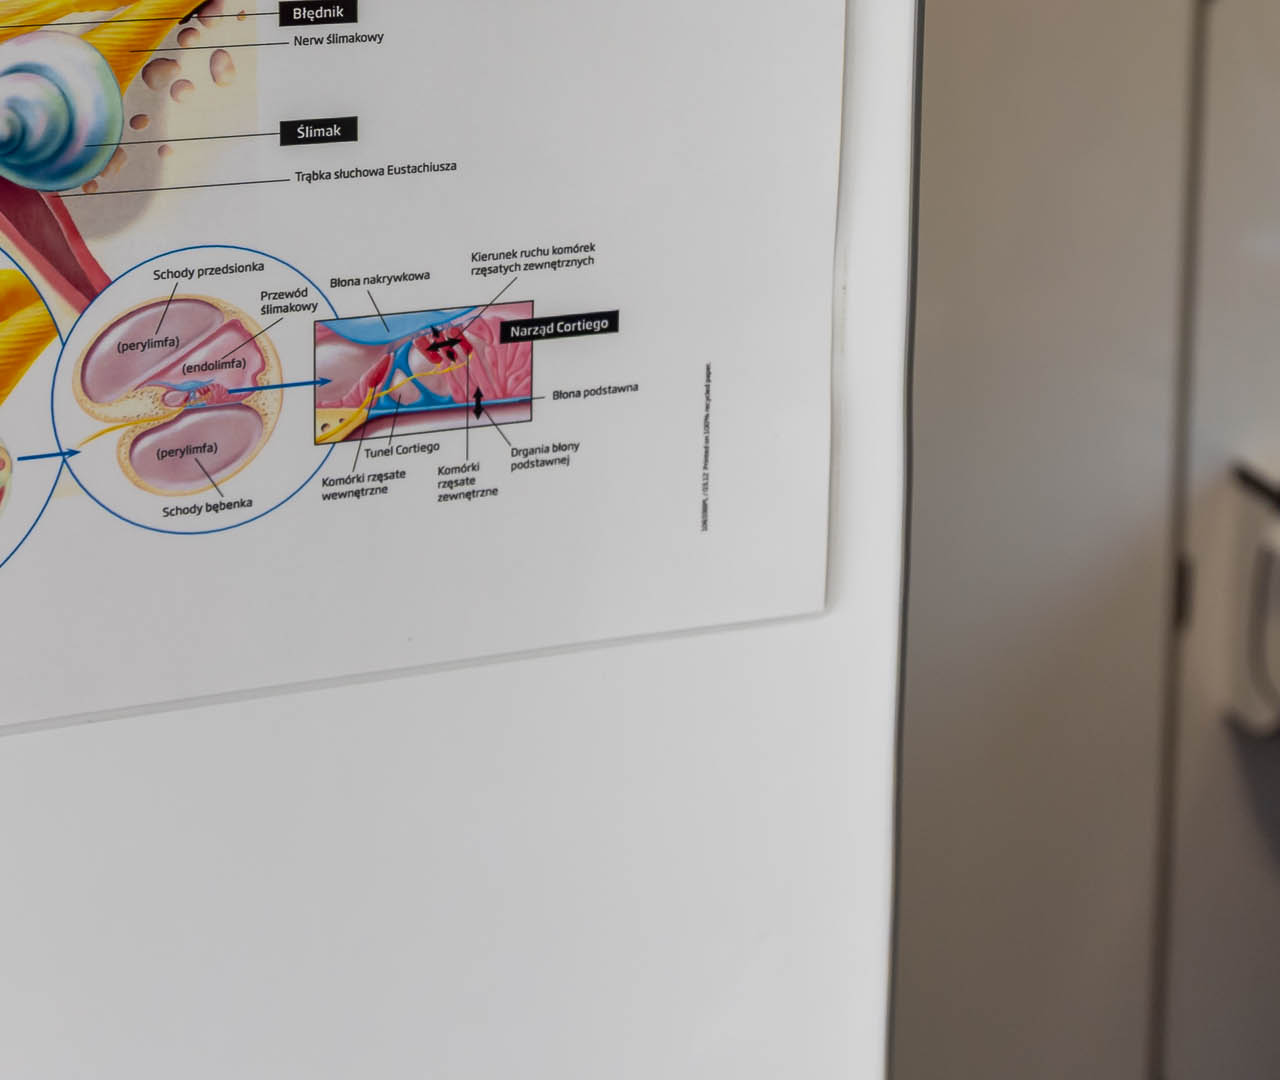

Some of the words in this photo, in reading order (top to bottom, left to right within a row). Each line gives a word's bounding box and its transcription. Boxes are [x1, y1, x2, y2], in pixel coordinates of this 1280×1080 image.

[292, 5, 344, 21] Błędnik
[294, 36, 324, 46] Nerw
[326, 32, 384, 45] ślimakowy
[296, 124, 341, 139] Ślimak
[295, 170, 332, 184] Trąbka
[334, 166, 385, 180] słuchowa
[387, 161, 457, 176] Eustachiusza
[471, 249, 518, 263] Kierunek
[520, 247, 549, 259] ruchu
[552, 242, 596, 256] komórek
[153, 268, 195, 281] Schody
[197, 261, 264, 277] przedsionka
[470, 262, 521, 277] rzęsatych
[523, 256, 595, 272] zewnętrznych
[329, 276, 361, 289] Błona
[363, 270, 430, 286] nakrywkowa
[260, 288, 308, 301] Przewód
[260, 301, 318, 316] ślimakowy
[510, 324, 554, 339] Narząd
[557, 317, 609, 335] Cortiego
[117, 336, 180, 354] (perylimfa)
[182, 358, 247, 376] (endolimfa)
[552, 388, 582, 400] Błona
[583, 383, 638, 399] podstawna
[156, 442, 218, 461] (perylimfa)
[364, 447, 393, 458] Tunel
[396, 442, 440, 456] Cortiego
[510, 446, 549, 459] Drgania
[551, 441, 580, 456] błony
[438, 462, 480, 476] Komórki
[510, 455, 570, 471] podstawnej
[322, 474, 365, 488] Komórki
[367, 469, 406, 483] rzęsate
[438, 476, 476, 490] rzęsate
[322, 484, 388, 501] wewnętrzne
[438, 487, 498, 502] zewnętrzne
[162, 503, 203, 518] Schody
[205, 498, 252, 514] bębenka
